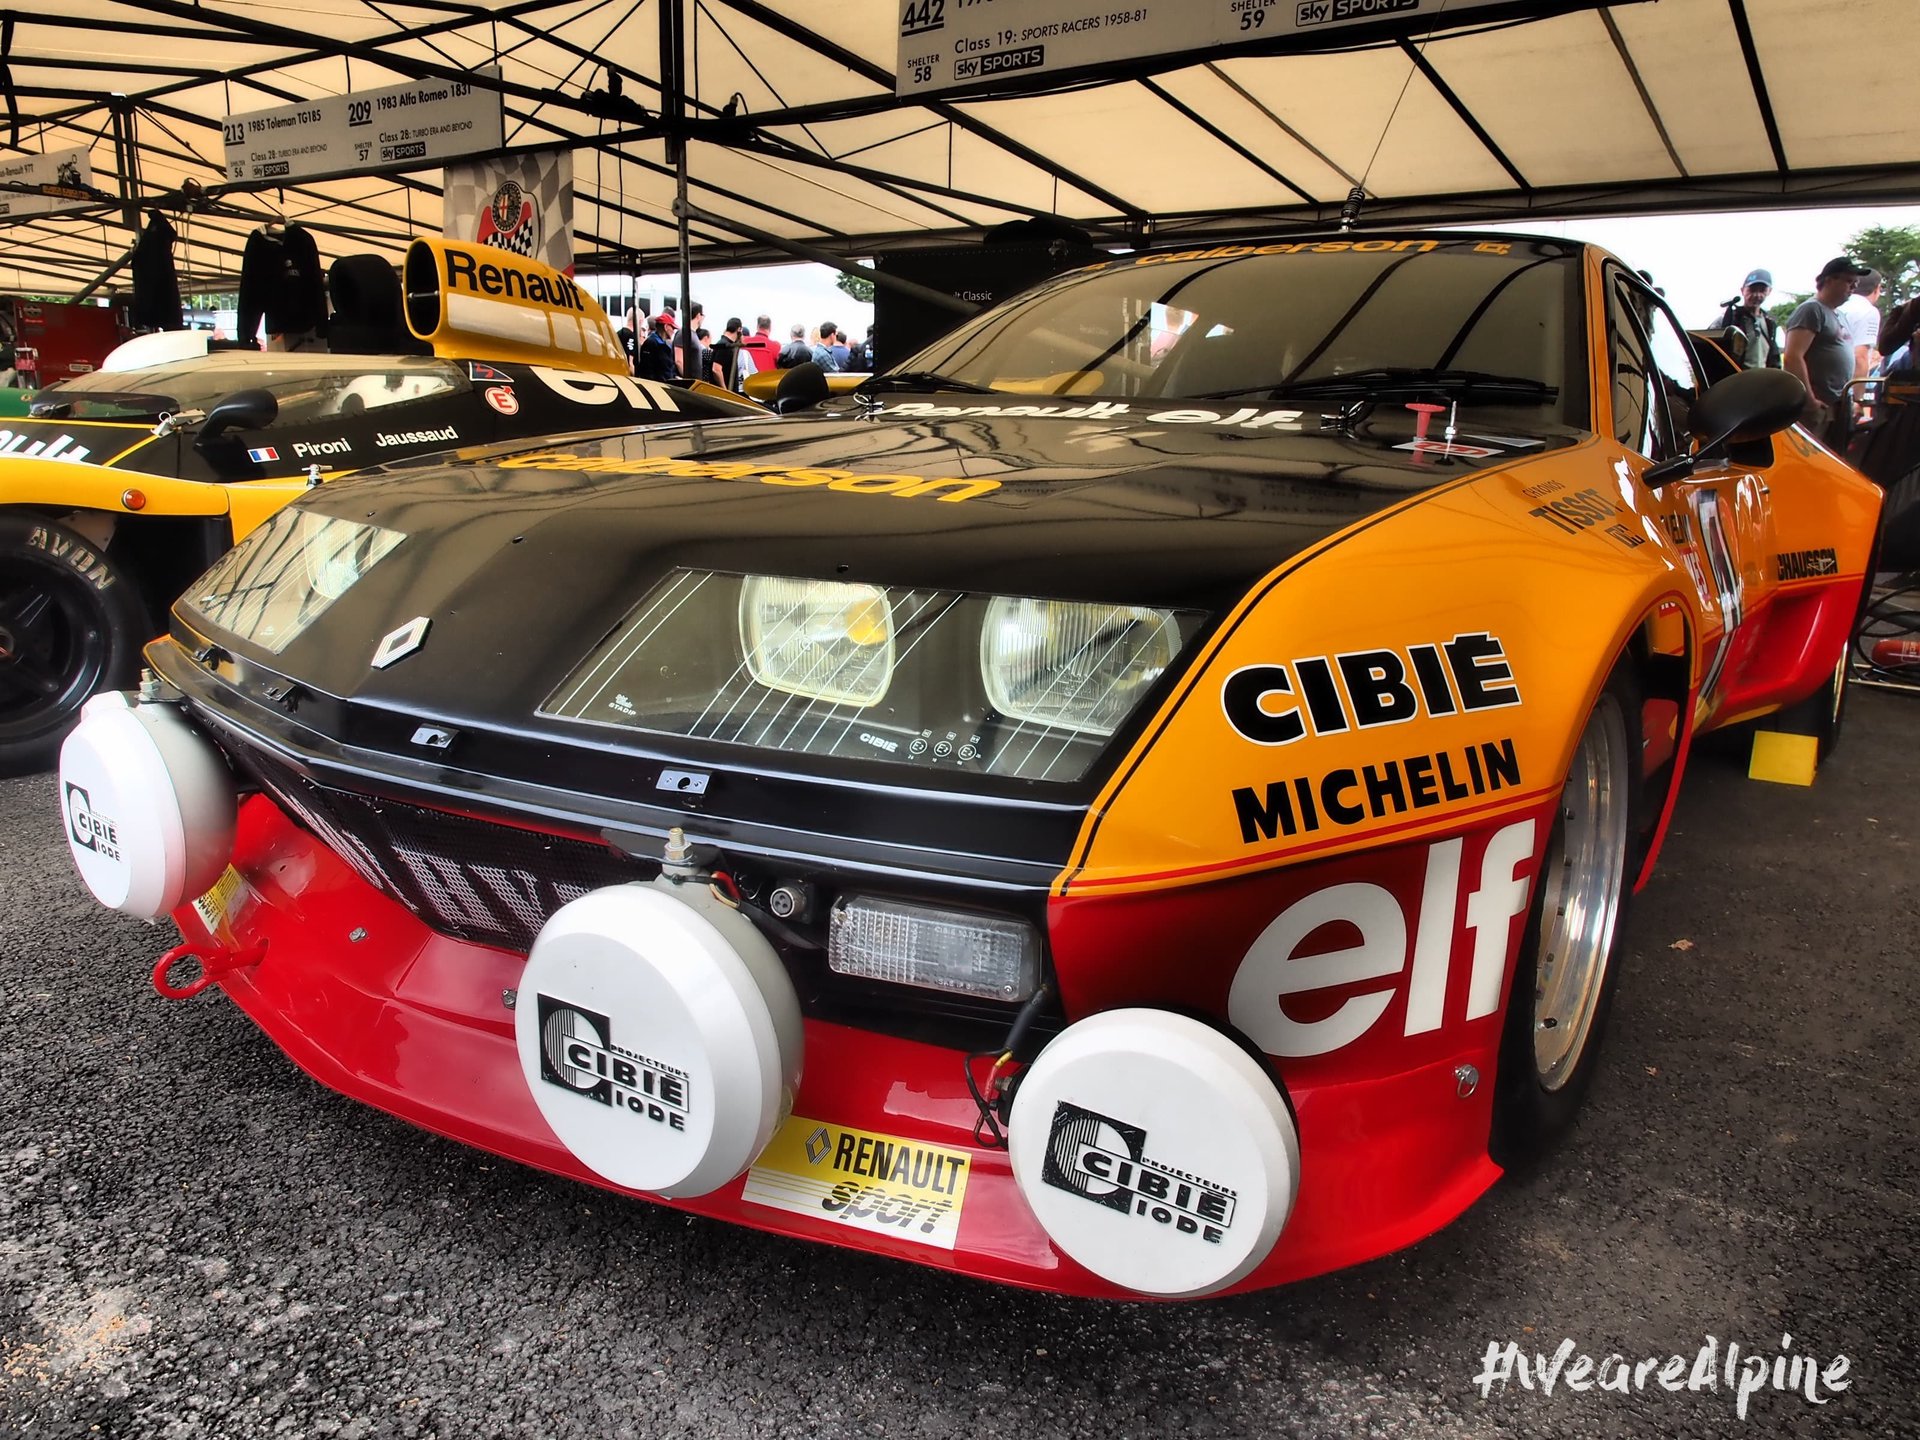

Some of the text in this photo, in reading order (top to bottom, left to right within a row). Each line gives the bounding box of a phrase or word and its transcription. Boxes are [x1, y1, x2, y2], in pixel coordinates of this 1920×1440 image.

[901, 0, 944, 29] 442
[1240, 9, 1265, 31] 59
[1300, 3, 1330, 22] sky
[954, 8, 1148, 54] Class 19: SPORTS RACERS 1958-81
[907, 53, 940, 68] SHELTER
[957, 49, 1041, 76] sky SPORTS
[914, 65, 932, 83] 58
[348, 100, 372, 123] 209
[376, 97, 398, 111] 1983
[399, 93, 417, 107] Alfa
[418, 89, 448, 104] Romeo
[248, 109, 321, 132] 1985 Toleman TG185
[224, 123, 245, 142] 213
[379, 132, 399, 143] Class
[400, 129, 412, 140] 28:
[250, 151, 267, 162] Class
[358, 149, 369, 162] 57
[382, 144, 425, 160] sky SPORTS
[234, 166, 244, 178] 56
[264, 162, 289, 175] SPORTS
[1134, 238, 1442, 265] calberson
[443, 248, 585, 312] Renault
[962, 289, 993, 302] Classic
[878, 400, 1304, 430] Renault elf
[292, 436, 353, 458] Pironi
[375, 425, 459, 448] Jaussaud
[498, 451, 1003, 503] calberson
[1527, 487, 1625, 536] TISSOT
[27, 526, 117, 590] AVON
[1231, 737, 1522, 845] MICHELIN
[96, 840, 121, 862] IODE
[1227, 818, 1536, 1058] elf
[610, 1043, 690, 1080] PROJECTEURS
[615, 1089, 686, 1133] IODE
[832, 1132, 966, 1196] RENAULT
[1141, 1156, 1239, 1198] PROJECTEURS
[821, 1180, 953, 1235] sport
[1136, 1198, 1225, 1246] IODE
